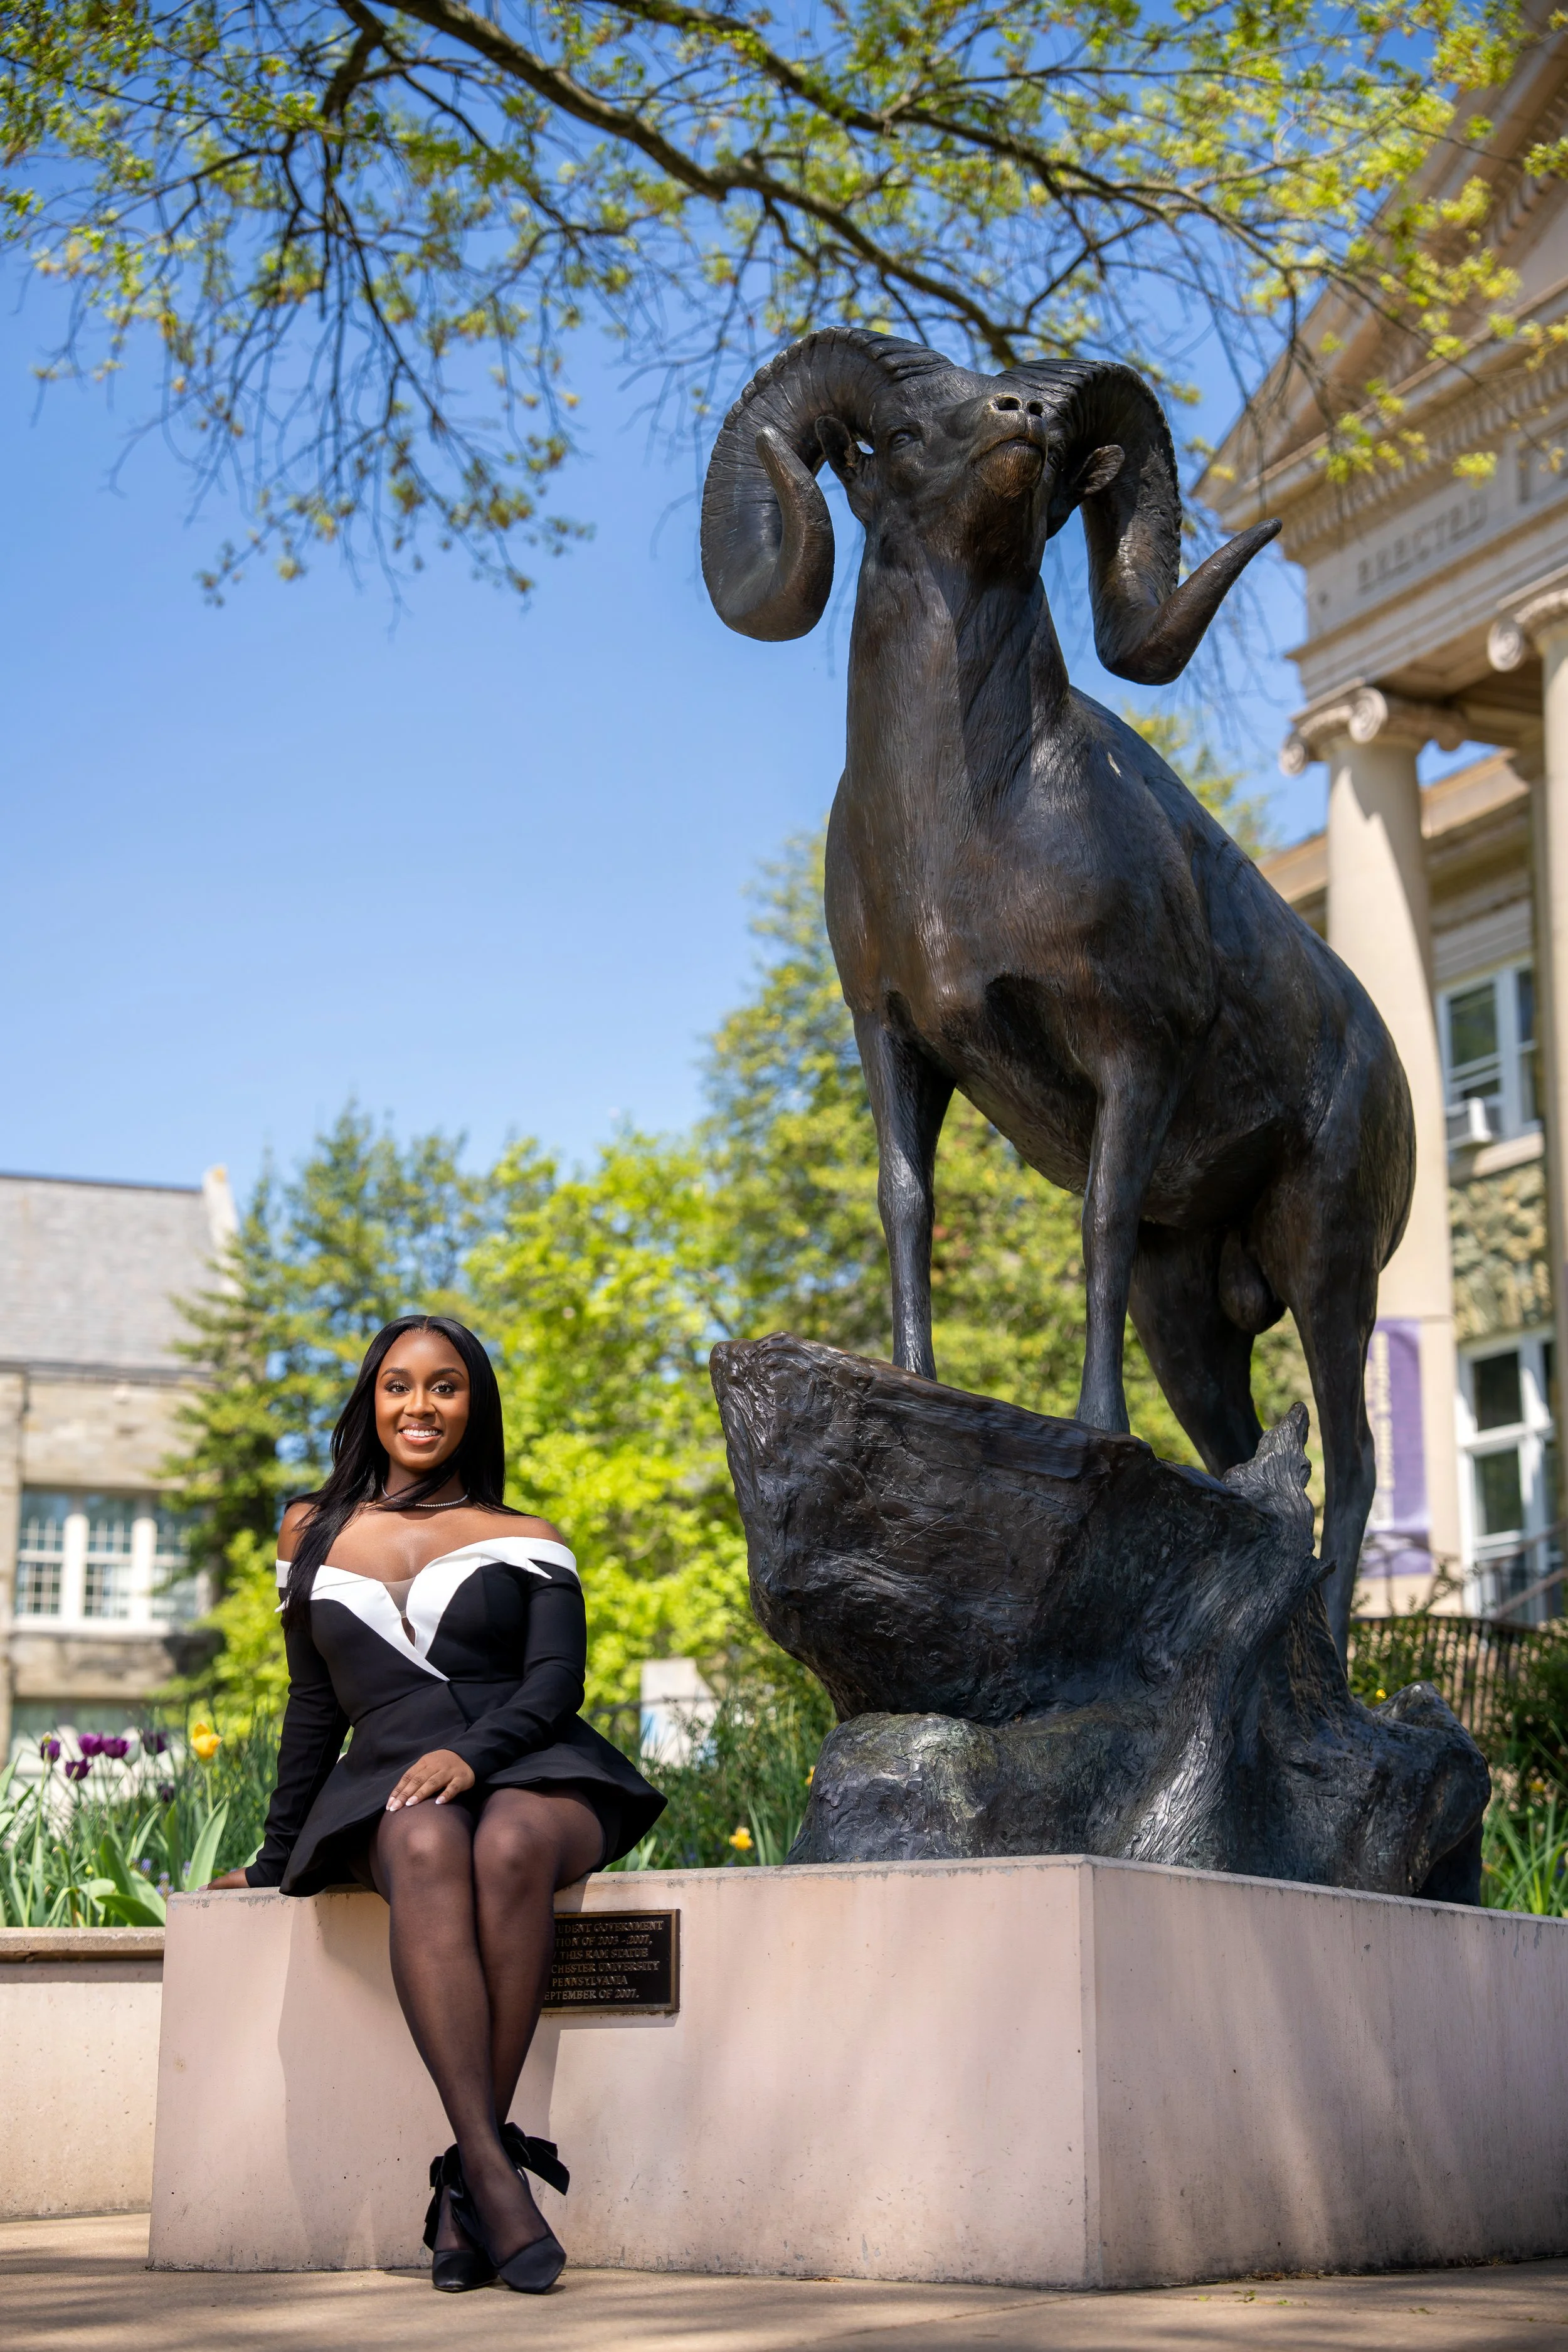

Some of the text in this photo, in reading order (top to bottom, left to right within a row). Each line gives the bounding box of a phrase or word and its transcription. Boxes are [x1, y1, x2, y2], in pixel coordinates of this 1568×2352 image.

[1357, 492, 1487, 595] ERECTED
[553, 1920, 664, 1934] TUDENT GOVERNMENT
[556, 1937, 578, 1947] TION
[581, 1937, 596, 1946] OF
[561, 1950, 583, 1960] THIS
[585, 1949, 608, 1959] RAM
[611, 1947, 648, 1958] STATUE
[551, 1961, 660, 1974] CHESTER UNIVERSITY
[551, 1975, 628, 1987] PENNSYLVANIA
[544, 1989, 597, 2000] EPTEMBER
[598, 1989, 613, 1999] OF
